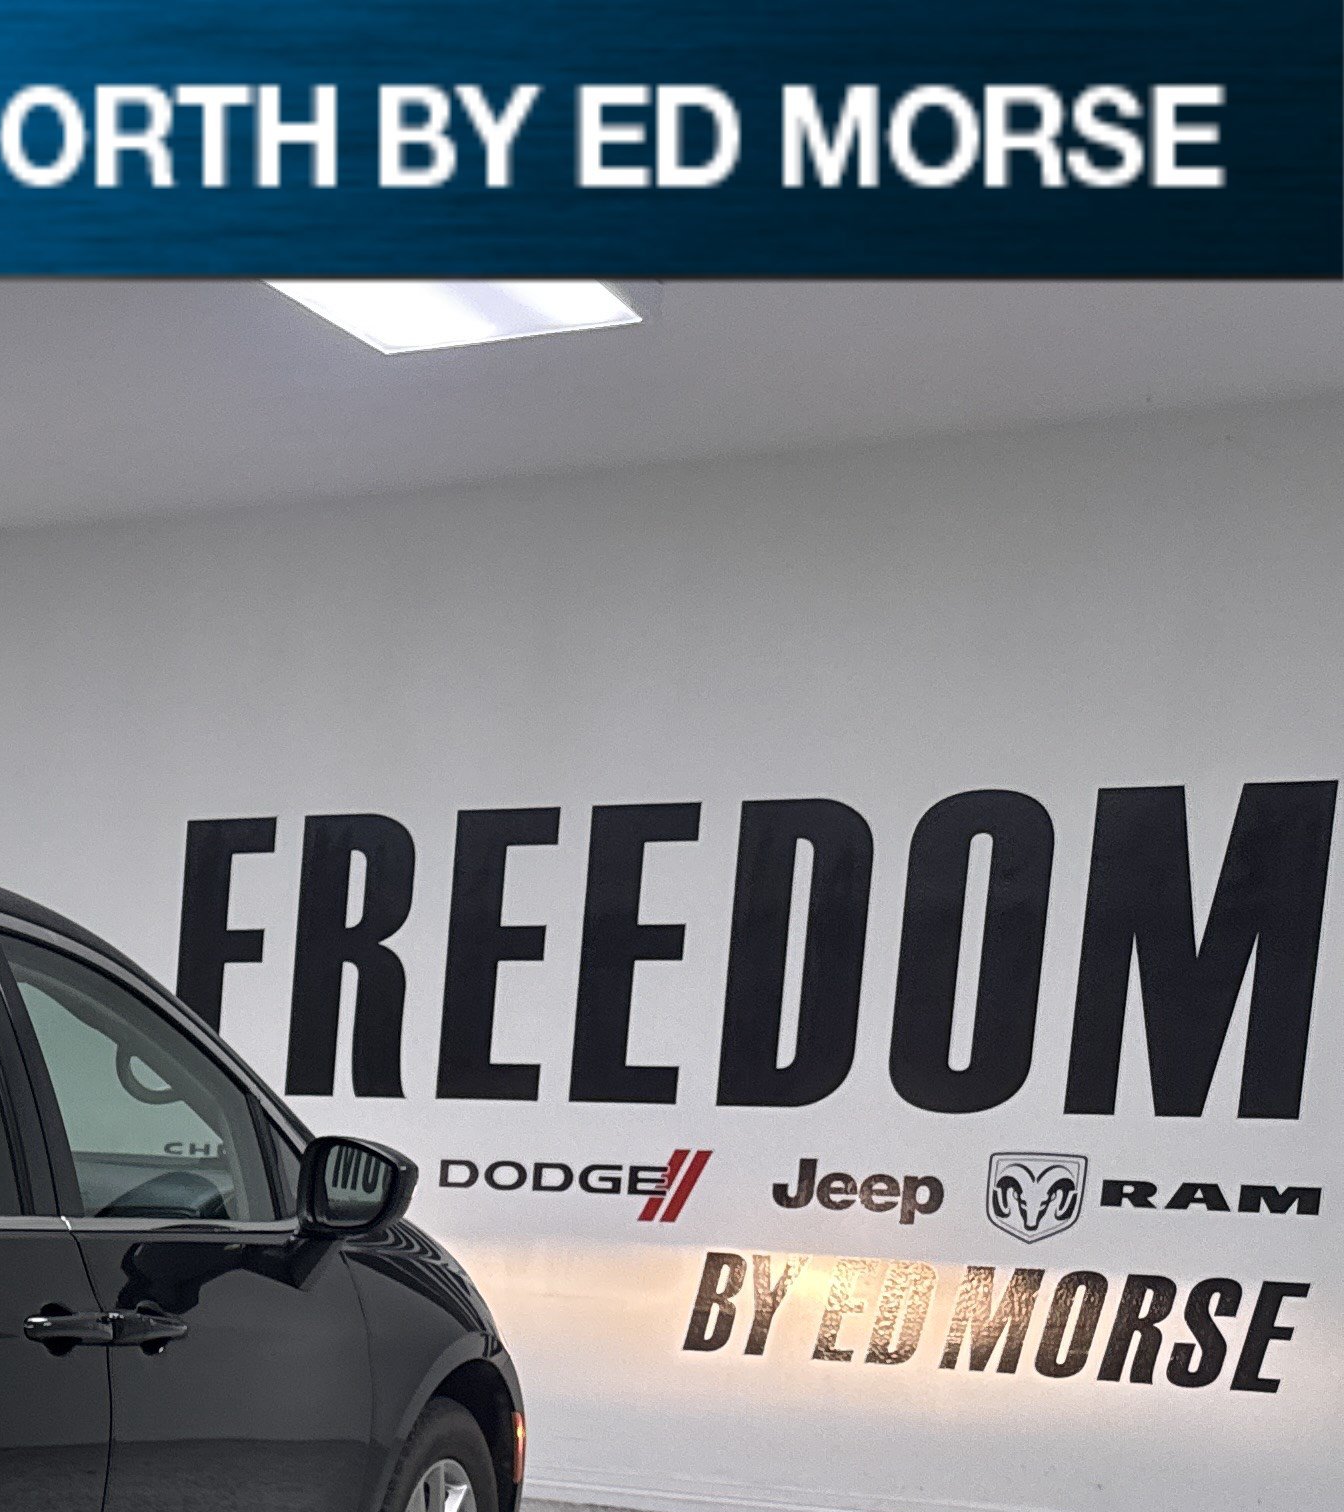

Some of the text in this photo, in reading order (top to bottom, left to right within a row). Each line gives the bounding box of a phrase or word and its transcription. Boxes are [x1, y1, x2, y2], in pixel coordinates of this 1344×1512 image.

[173, 778, 1338, 1120] FREEDOM
[438, 1158, 669, 1197] DODGE
[771, 1158, 945, 1226] Jeep
[1099, 1178, 1323, 1216] RAM
[681, 1250, 1312, 1395] BY ED MORSE
